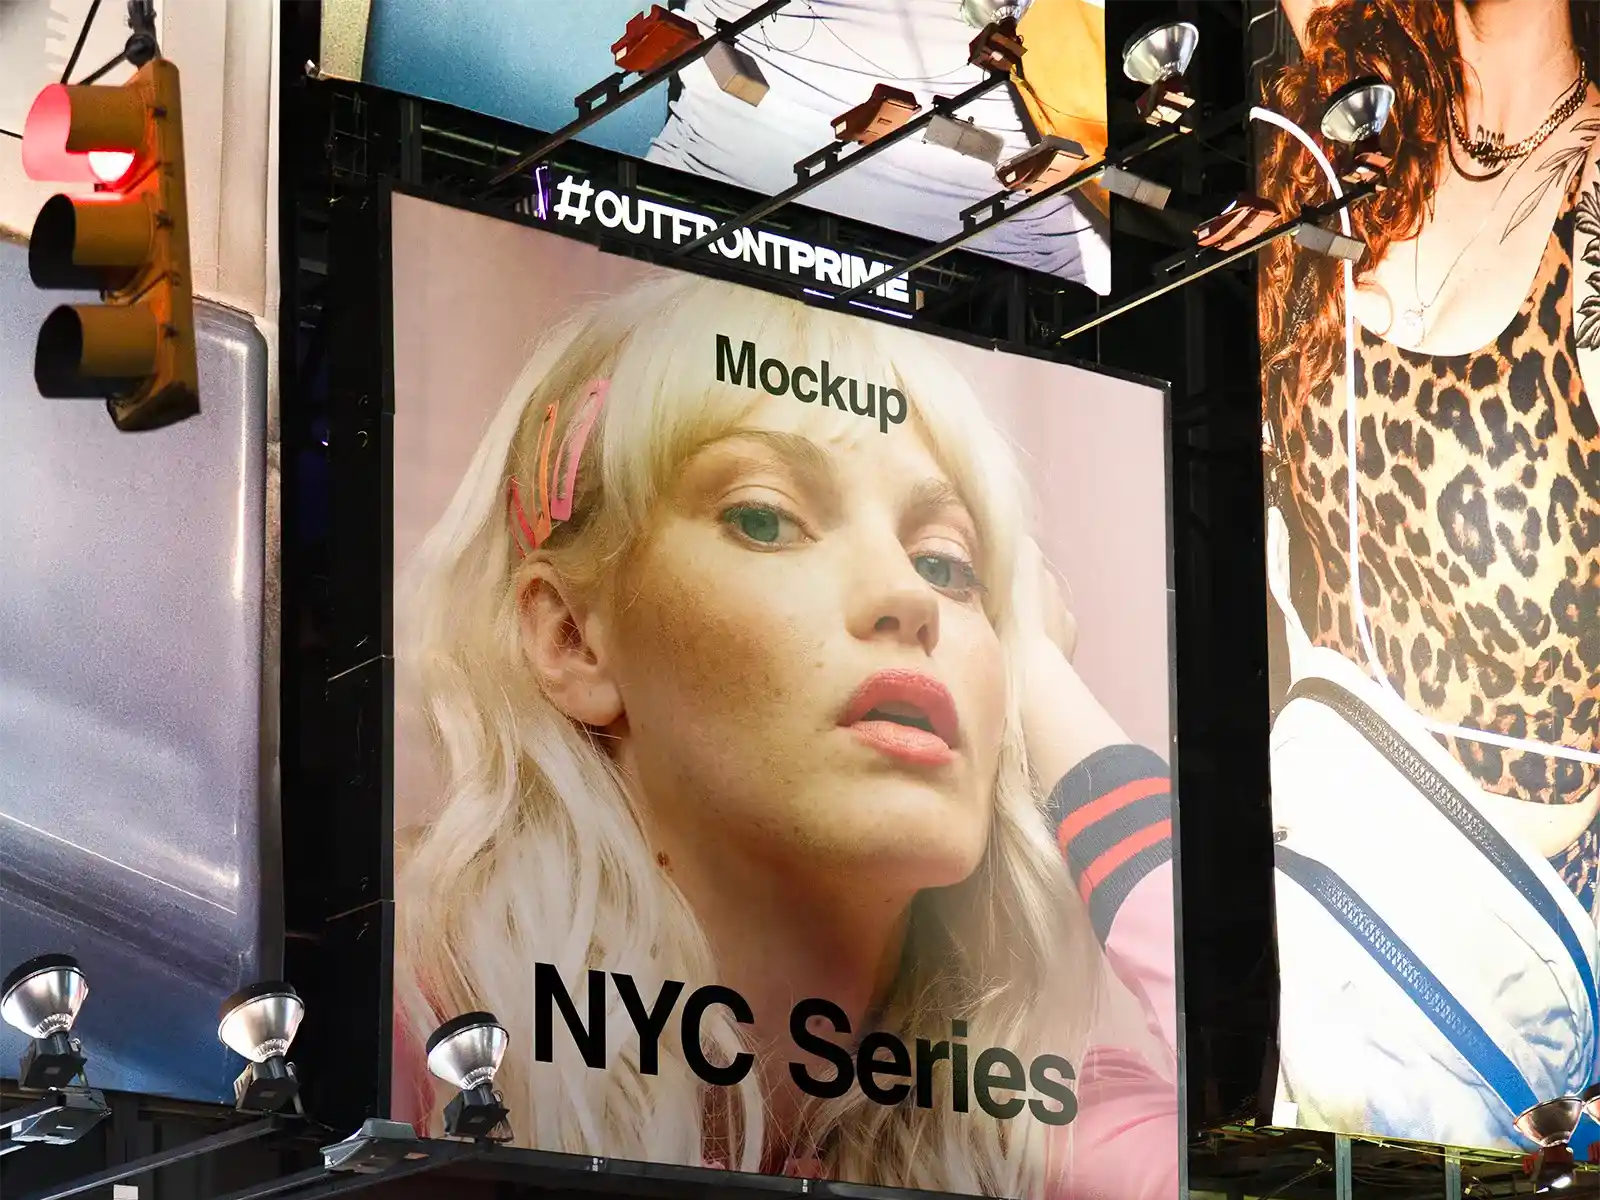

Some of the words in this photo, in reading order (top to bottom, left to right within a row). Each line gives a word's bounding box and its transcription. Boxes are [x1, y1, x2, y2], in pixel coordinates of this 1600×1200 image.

[553, 174, 910, 303] #OUTFRONTPRIME
[716, 333, 907, 433] Mockup
[534, 962, 755, 1086] NYC
[789, 998, 1078, 1126] Series
